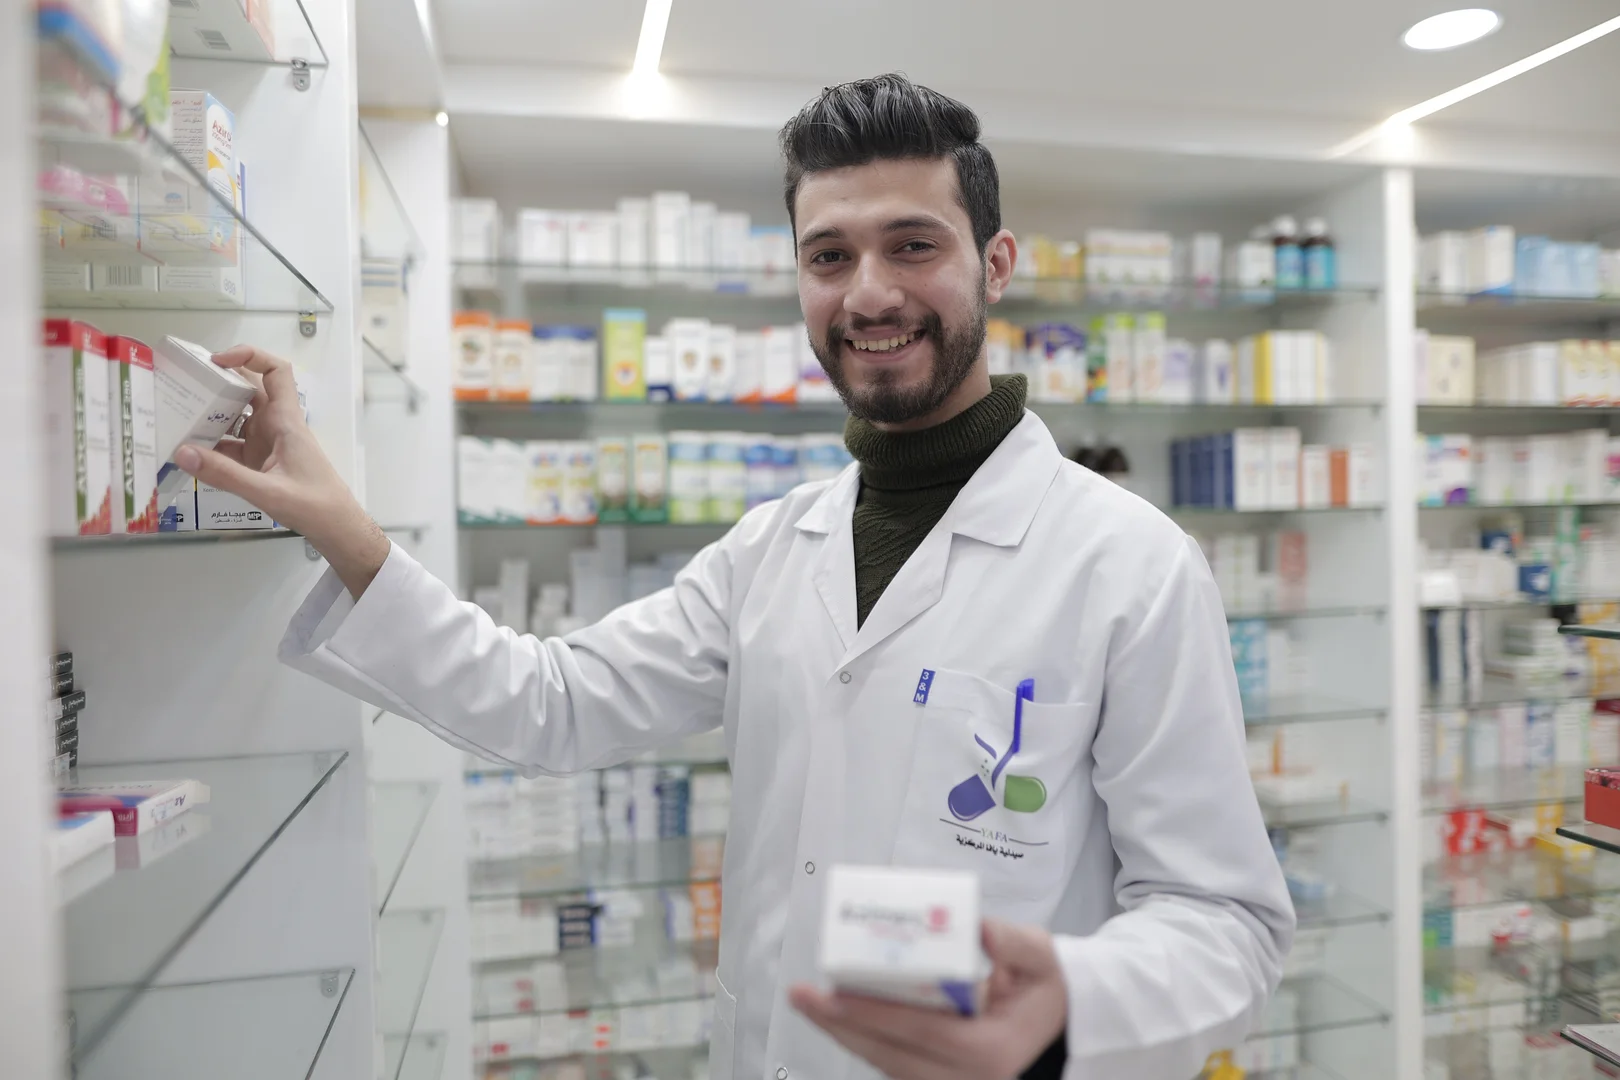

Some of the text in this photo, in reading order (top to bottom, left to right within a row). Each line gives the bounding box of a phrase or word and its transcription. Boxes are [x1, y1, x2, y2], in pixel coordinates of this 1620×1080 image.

[981, 828, 1008, 843] YAFA
[956, 834, 1024, 859] صيدلية يافا المركزية
